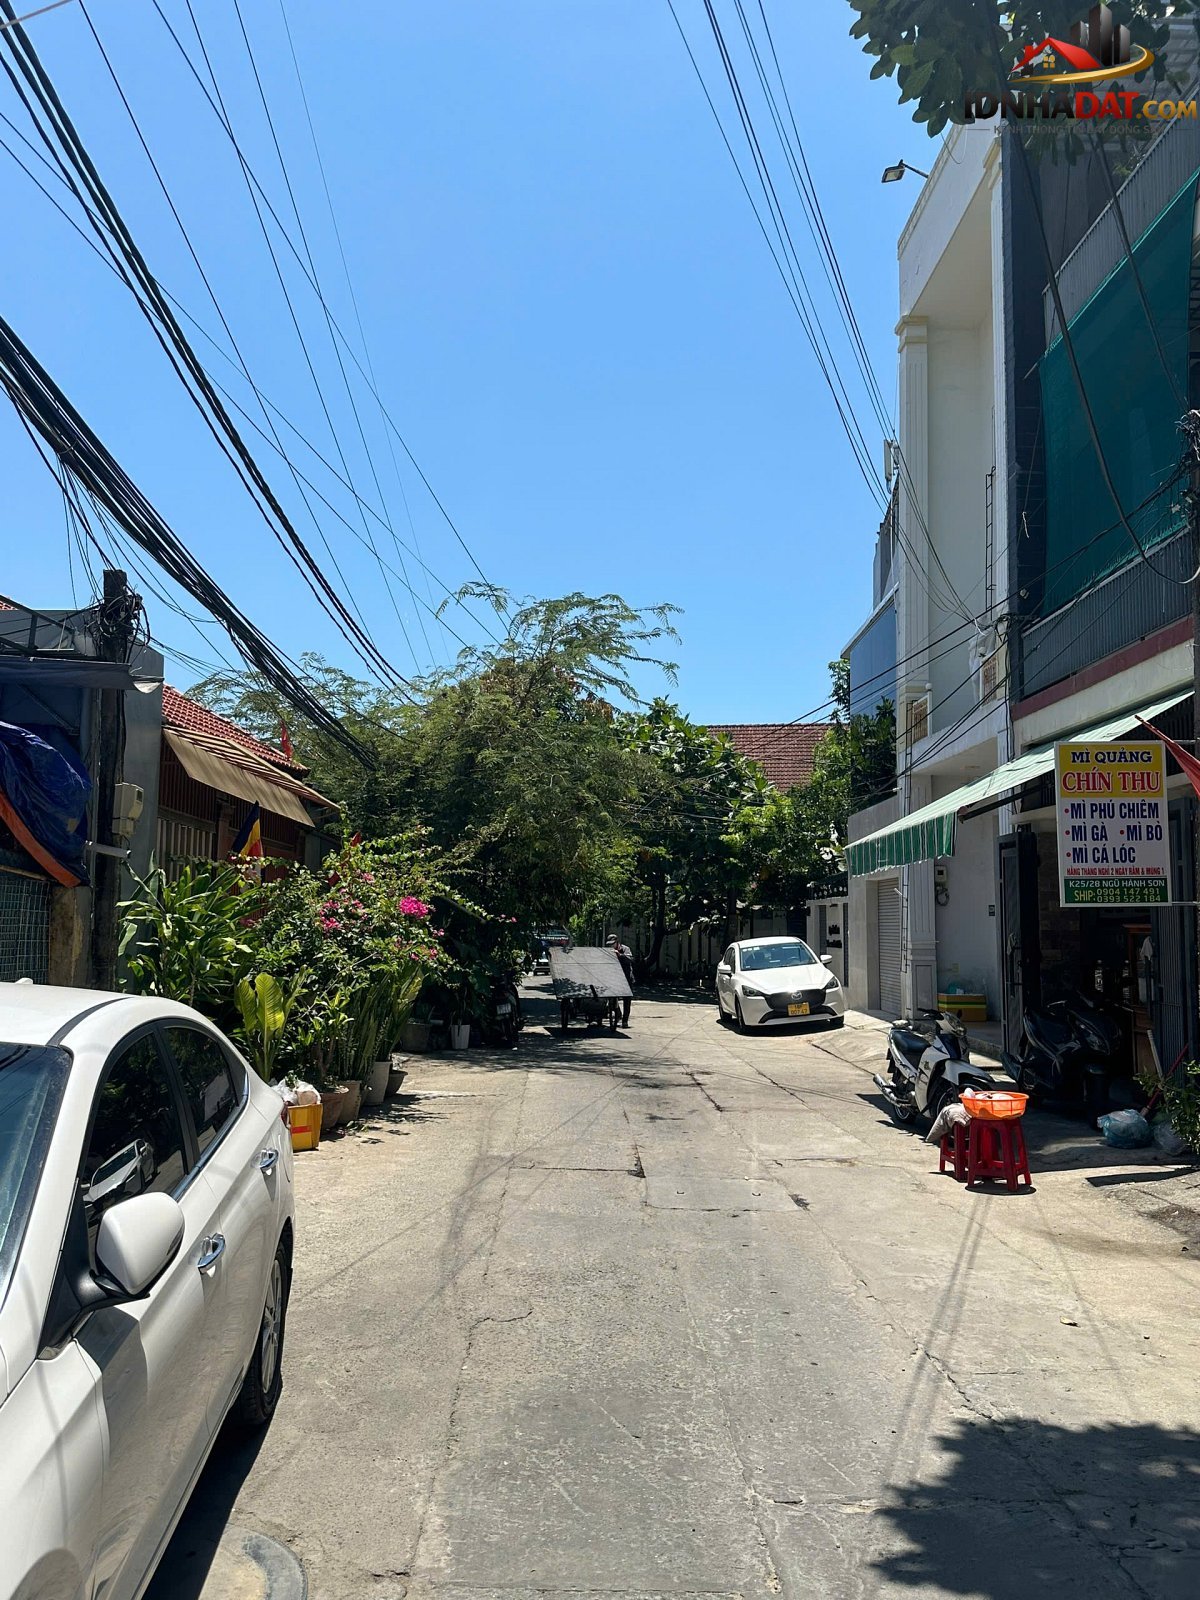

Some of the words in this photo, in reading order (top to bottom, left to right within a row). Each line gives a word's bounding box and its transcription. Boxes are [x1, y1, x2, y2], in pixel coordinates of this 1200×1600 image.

[1071, 748, 1091, 763] MÌ
[1094, 747, 1153, 764] QUẢNG
[1062, 766, 1112, 792] CHÍN
[1117, 771, 1160, 792] THU
[1070, 799, 1086, 819] MÌ
[1090, 799, 1115, 819] PHÚ
[1119, 799, 1159, 819] CHIÊM
[1071, 821, 1087, 842] MÌ
[1091, 821, 1109, 842] GÀ
[1126, 820, 1142, 841] MÌ
[1146, 820, 1163, 841] BÒ
[1072, 843, 1089, 864] MÌ
[1092, 843, 1110, 864] CÁ
[1112, 843, 1136, 864] LÓC
[1110, 867, 1115, 875] 2
[1069, 880, 1100, 888] K25/28
[1102, 878, 1120, 887] NGŨ
[1121, 879, 1146, 887] HÀNH
[1148, 879, 1165, 887] SƠN
[1074, 890, 1096, 901] SHIP:
[1096, 888, 1120, 896] 0904
[1143, 887, 1160, 895] 491
[1097, 895, 1121, 903] 0393
[1144, 894, 1161, 902] 184
